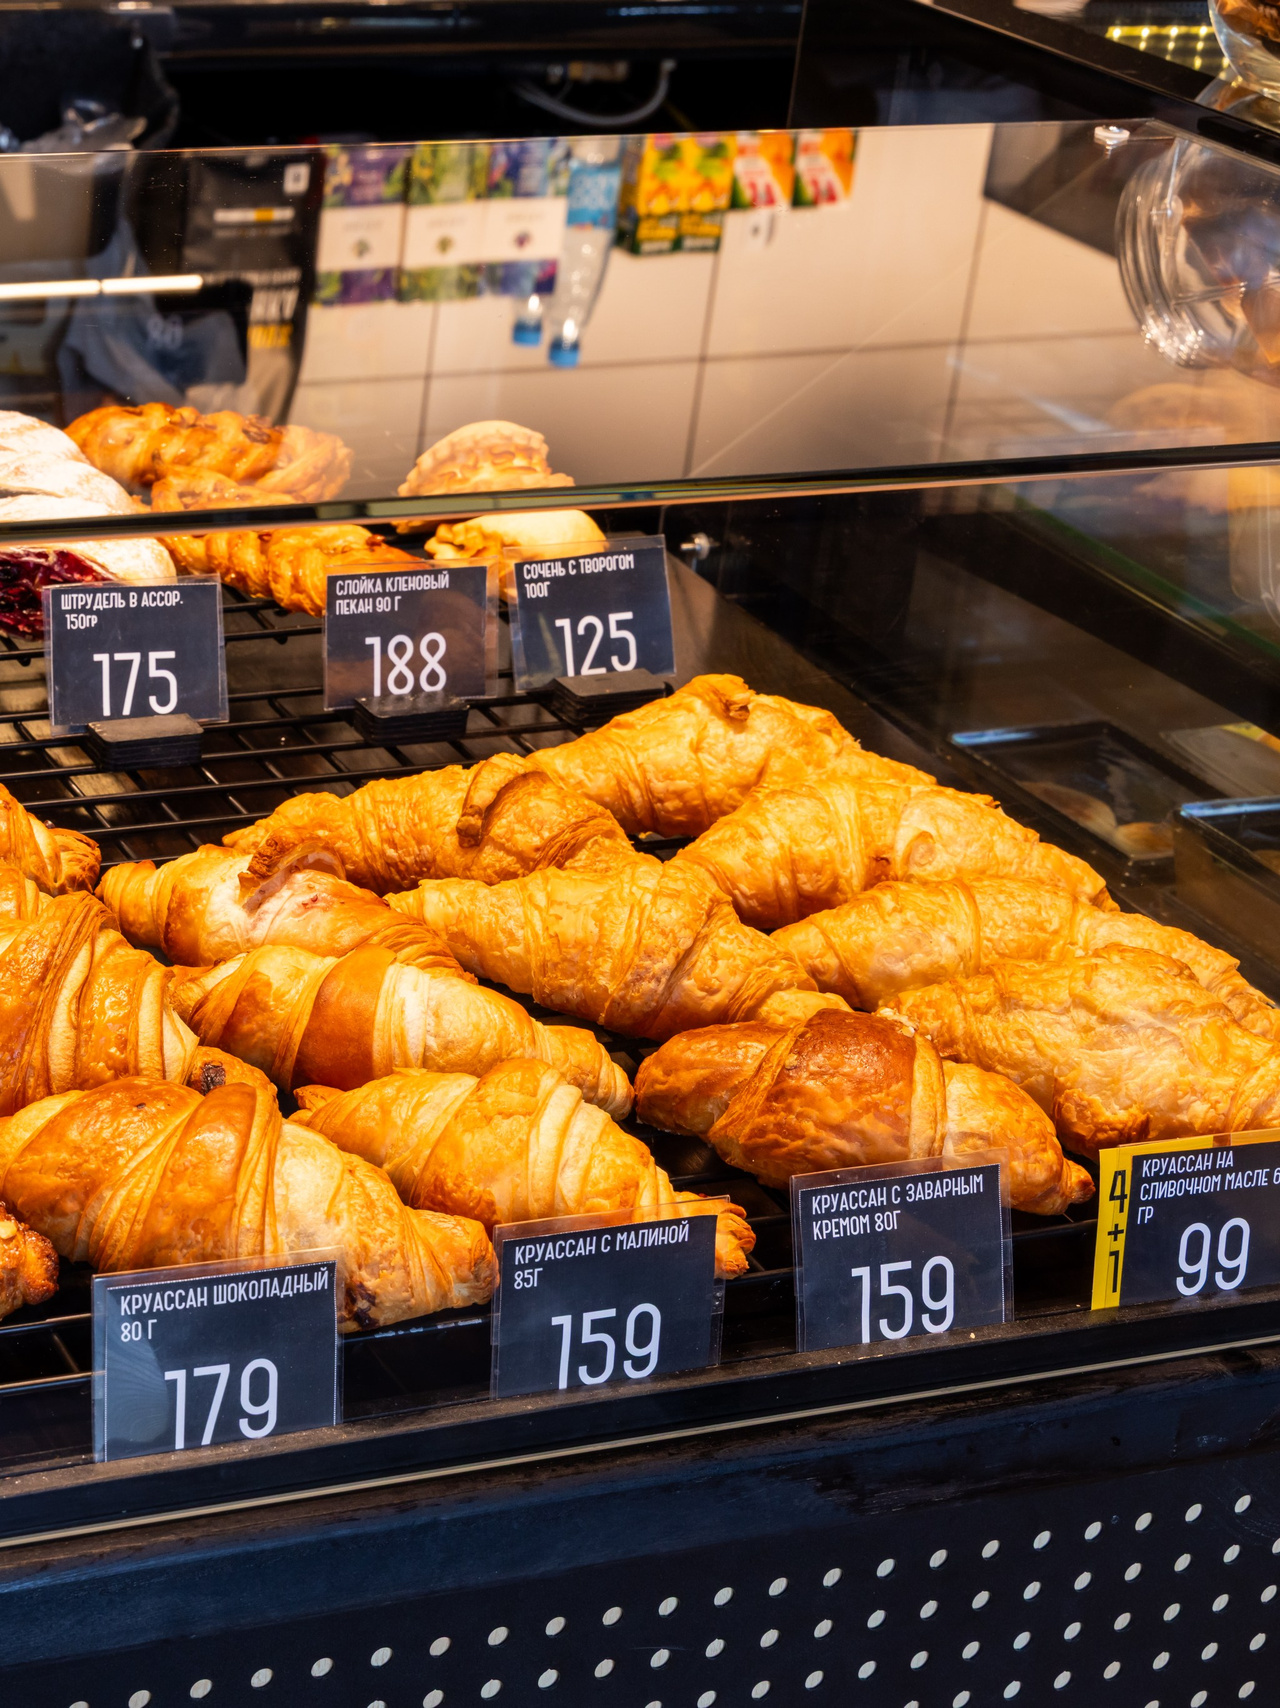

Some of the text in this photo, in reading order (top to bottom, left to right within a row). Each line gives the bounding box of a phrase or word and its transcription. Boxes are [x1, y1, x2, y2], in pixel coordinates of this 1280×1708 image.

[336, 570, 450, 596] СЛОЙКА КЛЕНОВЫЙ
[523, 554, 635, 580] СОЧЕНЬ С ТВОРОГОМ
[61, 590, 184, 611] ШТРУДЕЛЬ В АССОР.
[336, 596, 402, 616] ПЕКАН 90 Г
[525, 581, 550, 599] 100Г
[555, 611, 638, 677] 125
[365, 632, 447, 698] 188
[93, 650, 178, 717] 175
[1142, 1150, 1234, 1178] КРУАССАН НА
[812, 1173, 984, 1215] КРУАССАН С ЗАВАРНЫМ
[1140, 1173, 1223, 1201] СЛИВОЧНОМ
[1224, 1168, 1271, 1191] МАСЛЕ
[813, 1210, 901, 1241] КРЕМОМ 80Г
[1137, 1206, 1154, 1225] ГР
[514, 1220, 690, 1266] КРУАССАН С МАЛИНОЙ
[1176, 1217, 1251, 1296] 99
[120, 1266, 329, 1316] КРУАССАН ШОКОЛАДНЫЙ
[513, 1268, 543, 1290] 85Г
[851, 1255, 955, 1344] 159
[120, 1319, 158, 1343] 80 Г
[551, 1302, 661, 1390] 159
[164, 1358, 278, 1450] 179
